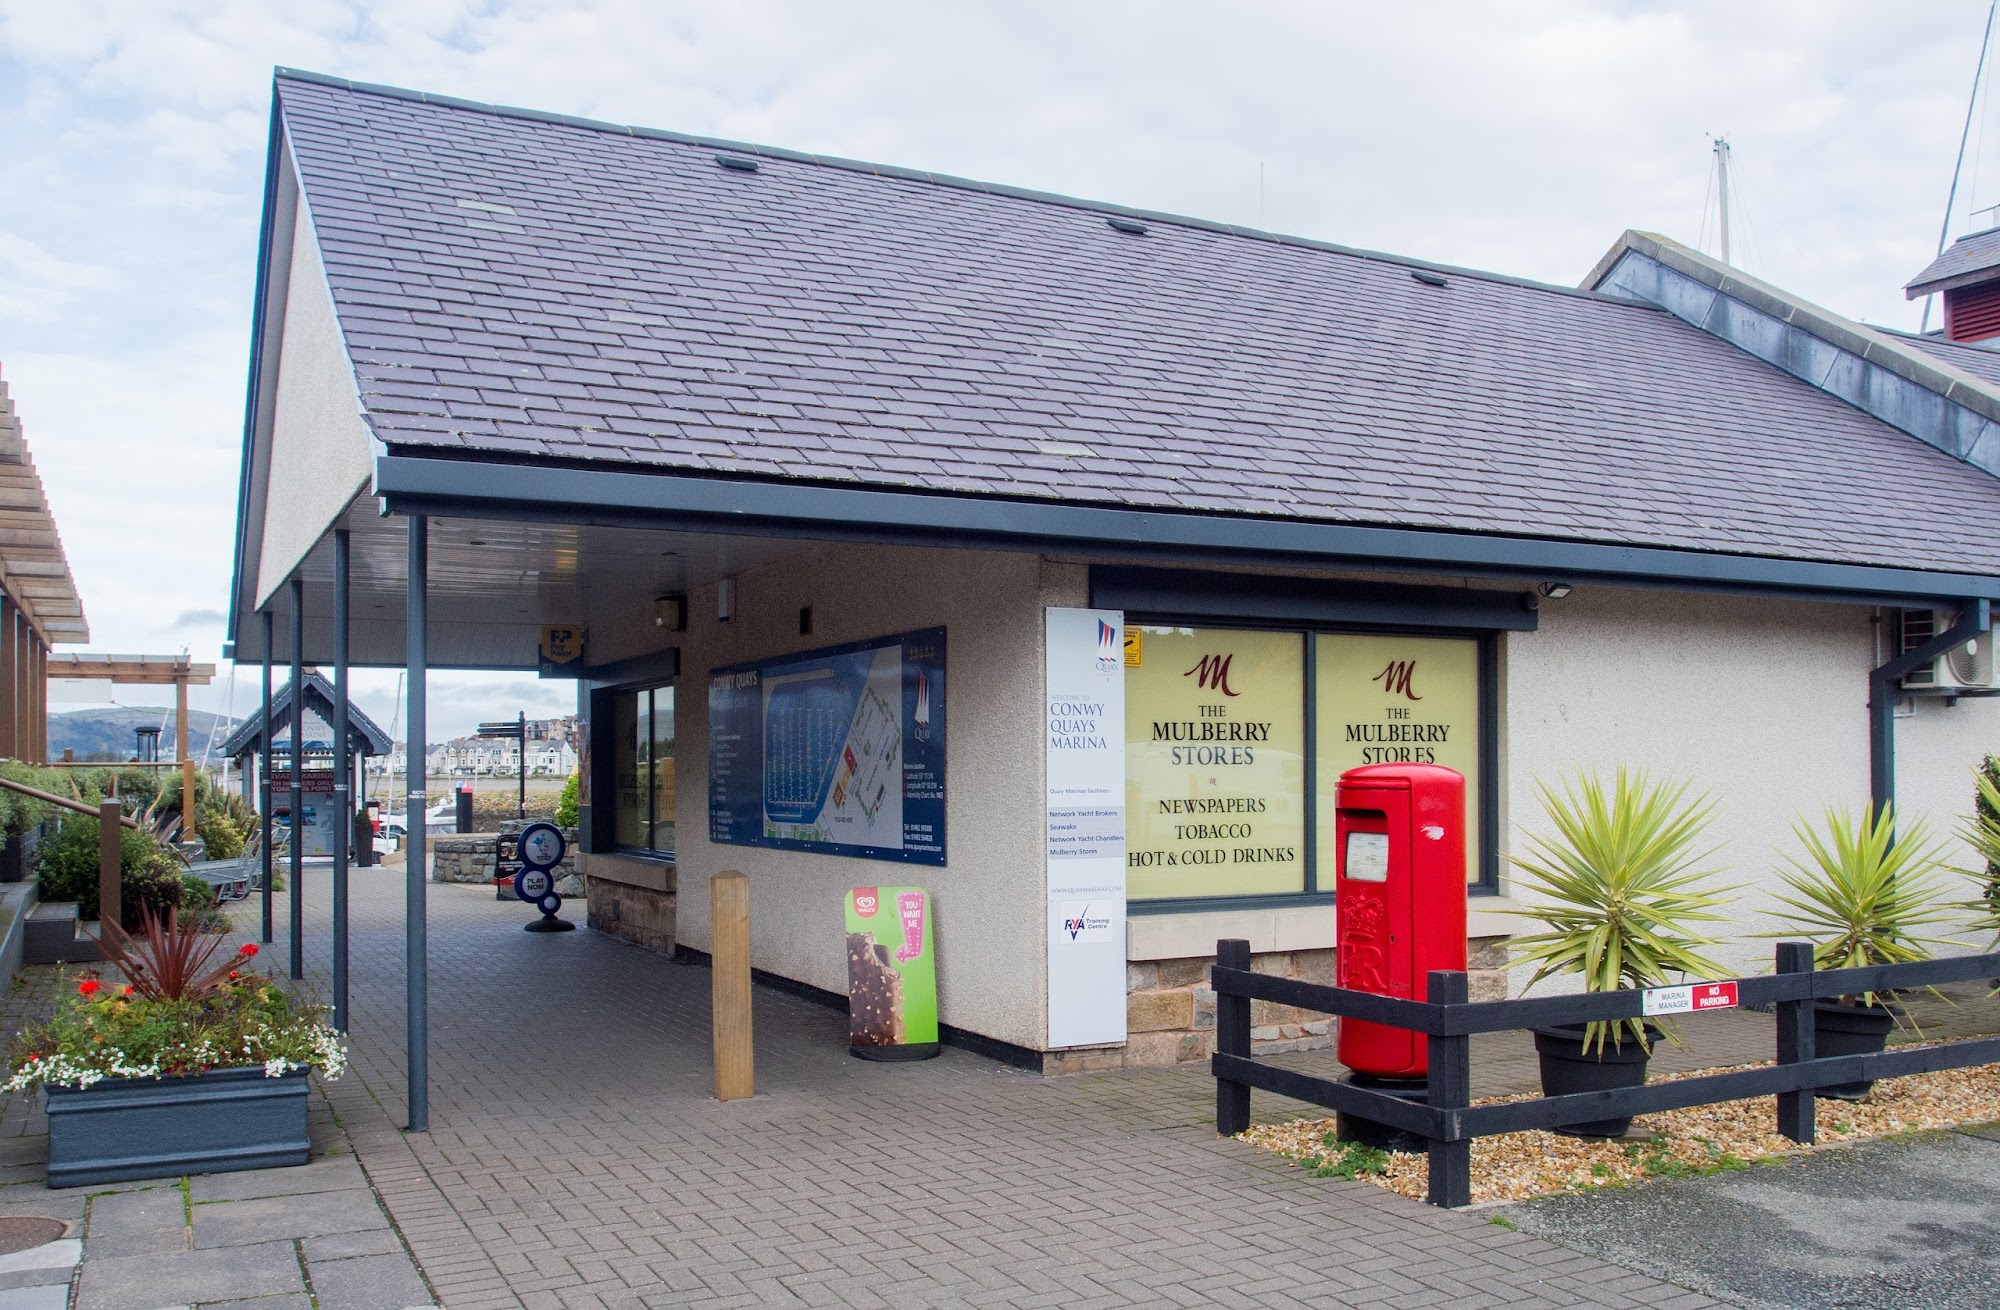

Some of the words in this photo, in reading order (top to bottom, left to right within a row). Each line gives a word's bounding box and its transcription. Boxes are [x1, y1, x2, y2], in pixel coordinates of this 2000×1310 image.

[713, 674, 735, 691] CONWY
[736, 670, 758, 690] QUAYS
[1050, 703, 1105, 717] CONWY
[1198, 705, 1227, 717] THE
[1385, 708, 1411, 719] THE
[1050, 719, 1096, 736] QUAYS
[1152, 722, 1271, 741] MULBERRY
[1345, 724, 1450, 742] MULBERRY
[1050, 736, 1107, 749] MARINA
[1171, 746, 1254, 766] STORES
[1362, 746, 1435, 765] STORES
[1159, 798, 1266, 814] NEWSPAPERS
[1174, 823, 1252, 840] TOBACCO
[1128, 851, 1165, 867] HOT
[1167, 852, 1178, 866] &
[1181, 849, 1226, 866] COLD
[1233, 847, 1295, 864] DRINKS
[527, 877, 544, 885] PLAY
[1051, 886, 1122, 894] WWW.QUAYMARINAS.COM
[904, 901, 918, 909] YOU
[903, 910, 921, 919] WANT
[907, 920, 918, 928] ME
[1661, 992, 1686, 1001] MARINA
[1709, 986, 1720, 996] NO
[1658, 1000, 1689, 1009] MANAGER
[1700, 996, 1730, 1007] PARKING
